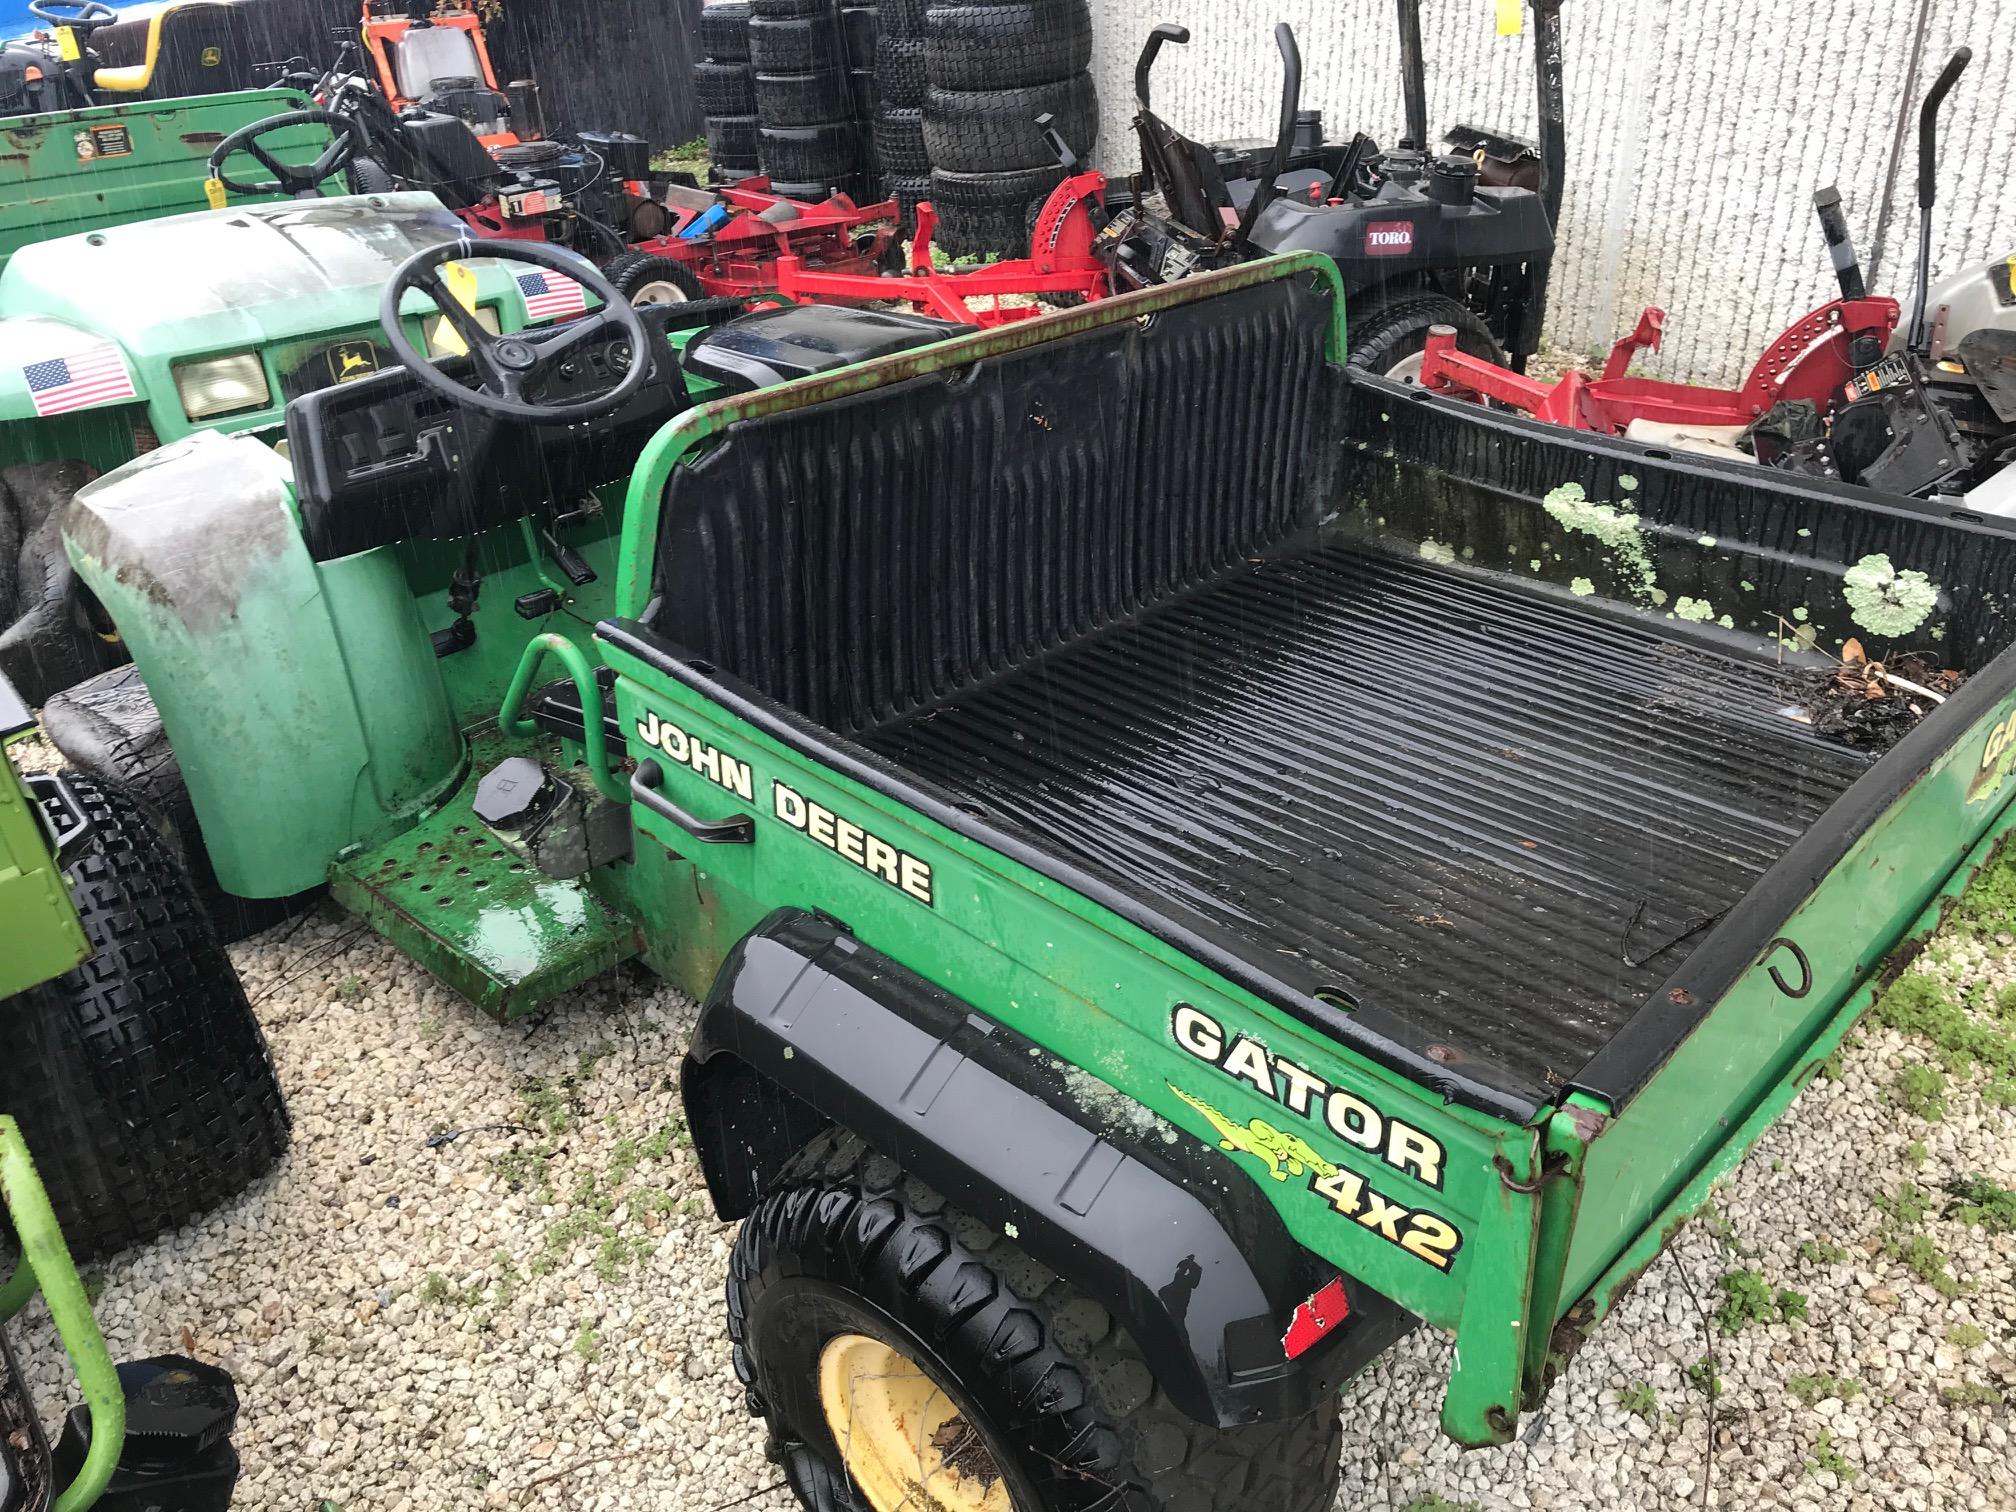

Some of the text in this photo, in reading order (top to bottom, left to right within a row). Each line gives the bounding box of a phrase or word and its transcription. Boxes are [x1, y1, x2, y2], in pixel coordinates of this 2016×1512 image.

[636, 709, 934, 907] JOHN DEERE
[1171, 1002, 1447, 1193] GATOR
[1308, 1163, 1464, 1274] 4x2
